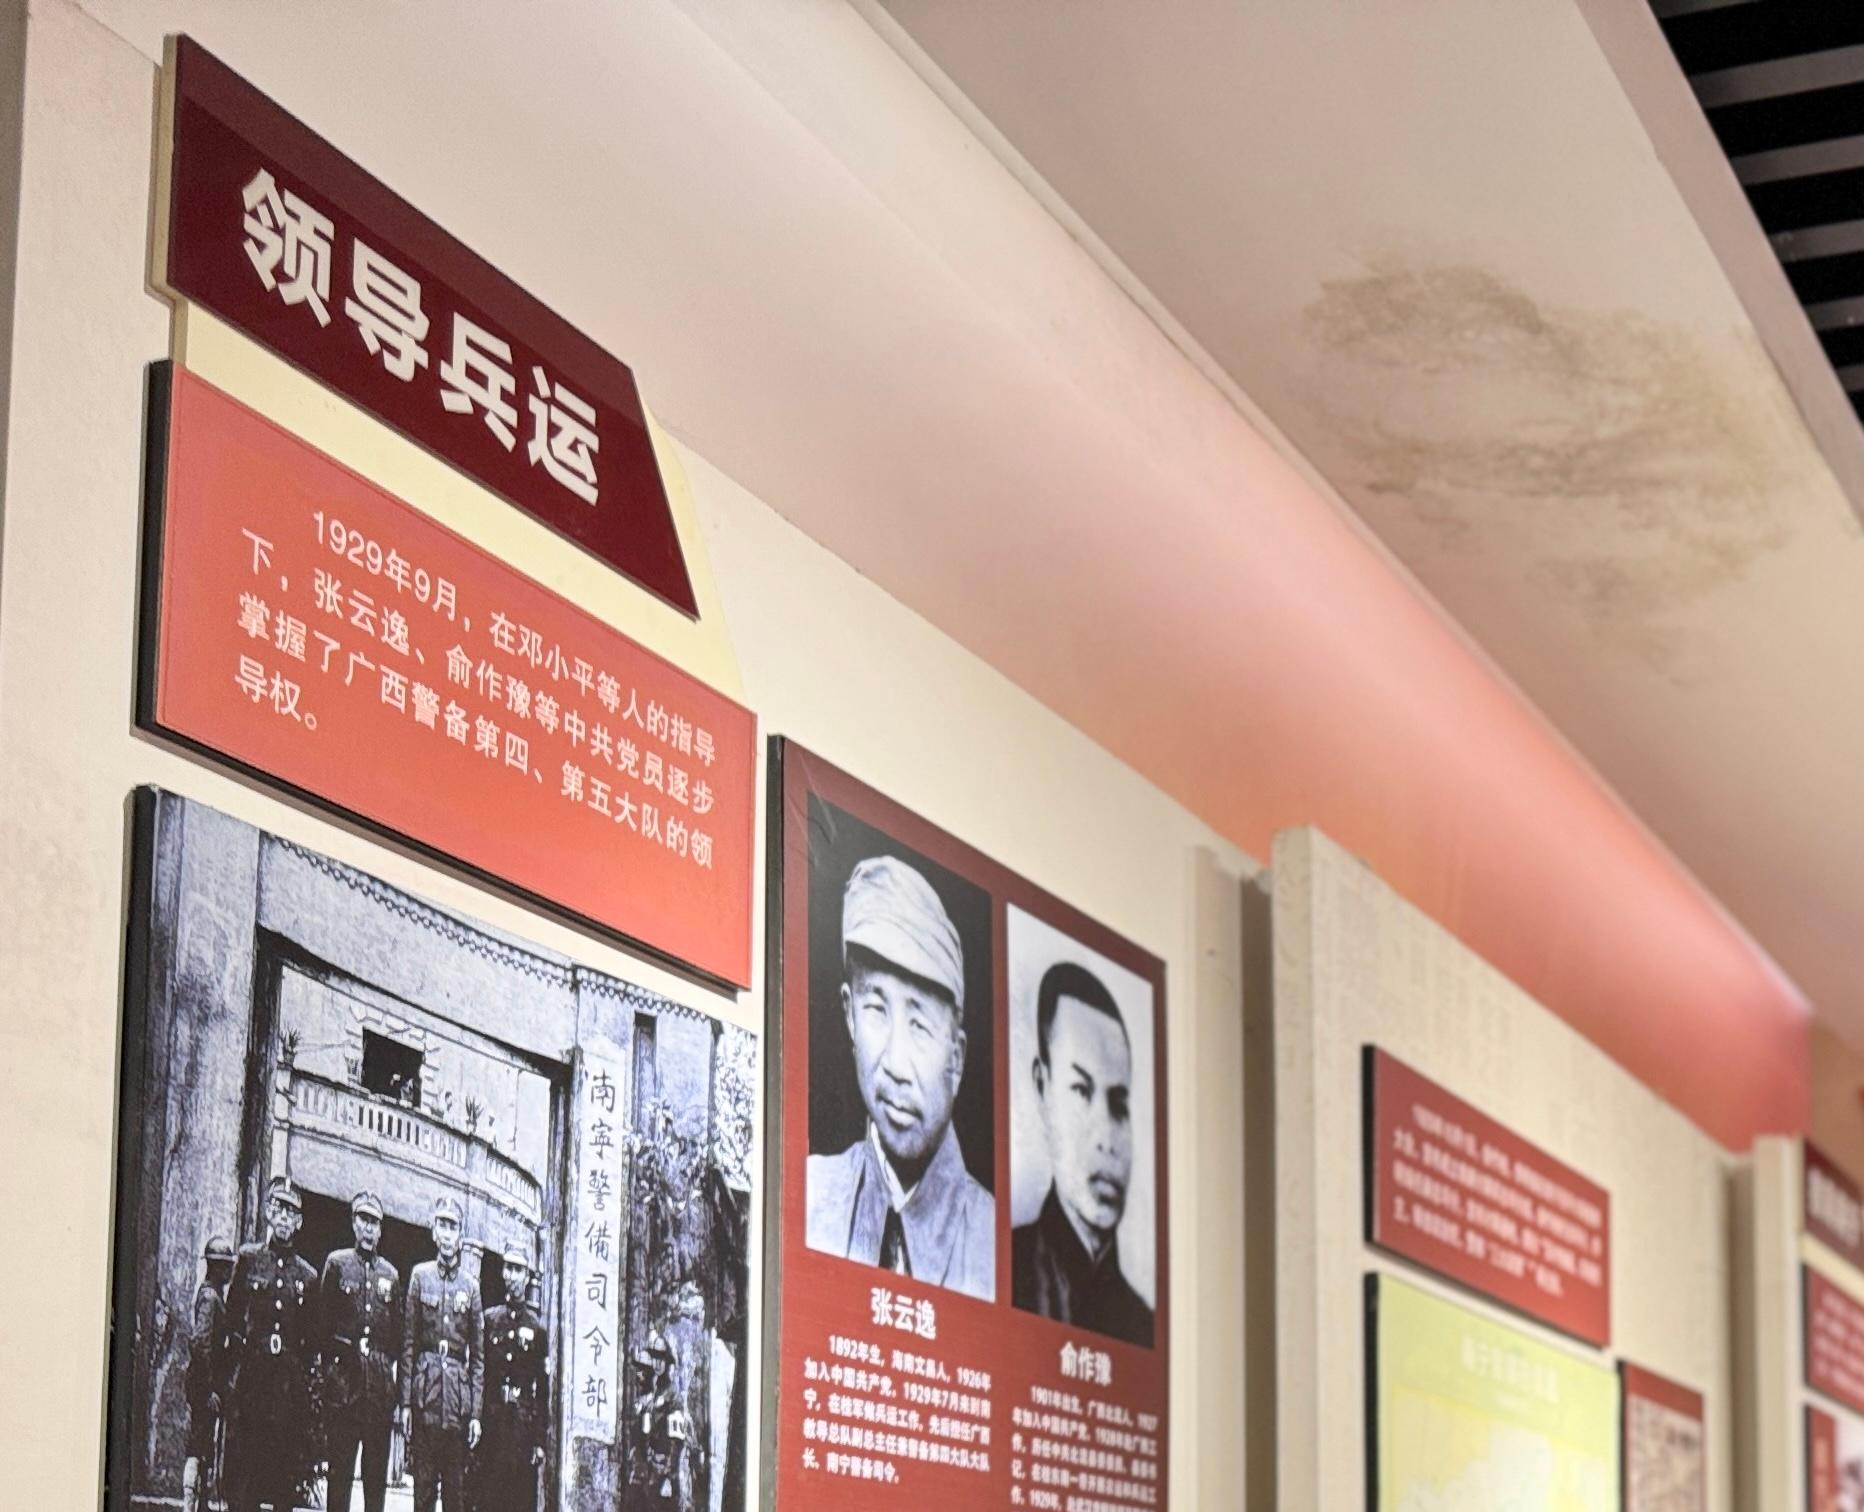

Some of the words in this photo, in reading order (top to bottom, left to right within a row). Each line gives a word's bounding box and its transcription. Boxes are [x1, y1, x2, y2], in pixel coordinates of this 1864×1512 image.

[239, 166, 600, 506] 领导兵运
[235, 666, 319, 733] 导权。
[237, 591, 713, 871] 掌握了广西警备第四、第五大队的领
[241, 527, 716, 814] 下，张云逸、俞作豫等中共党员逐步
[313, 509, 717, 767] 1929年9月，在邓小平等人的指导
[870, 1286, 937, 1340] 张云逸
[1060, 1341, 1112, 1386] 俞作豫
